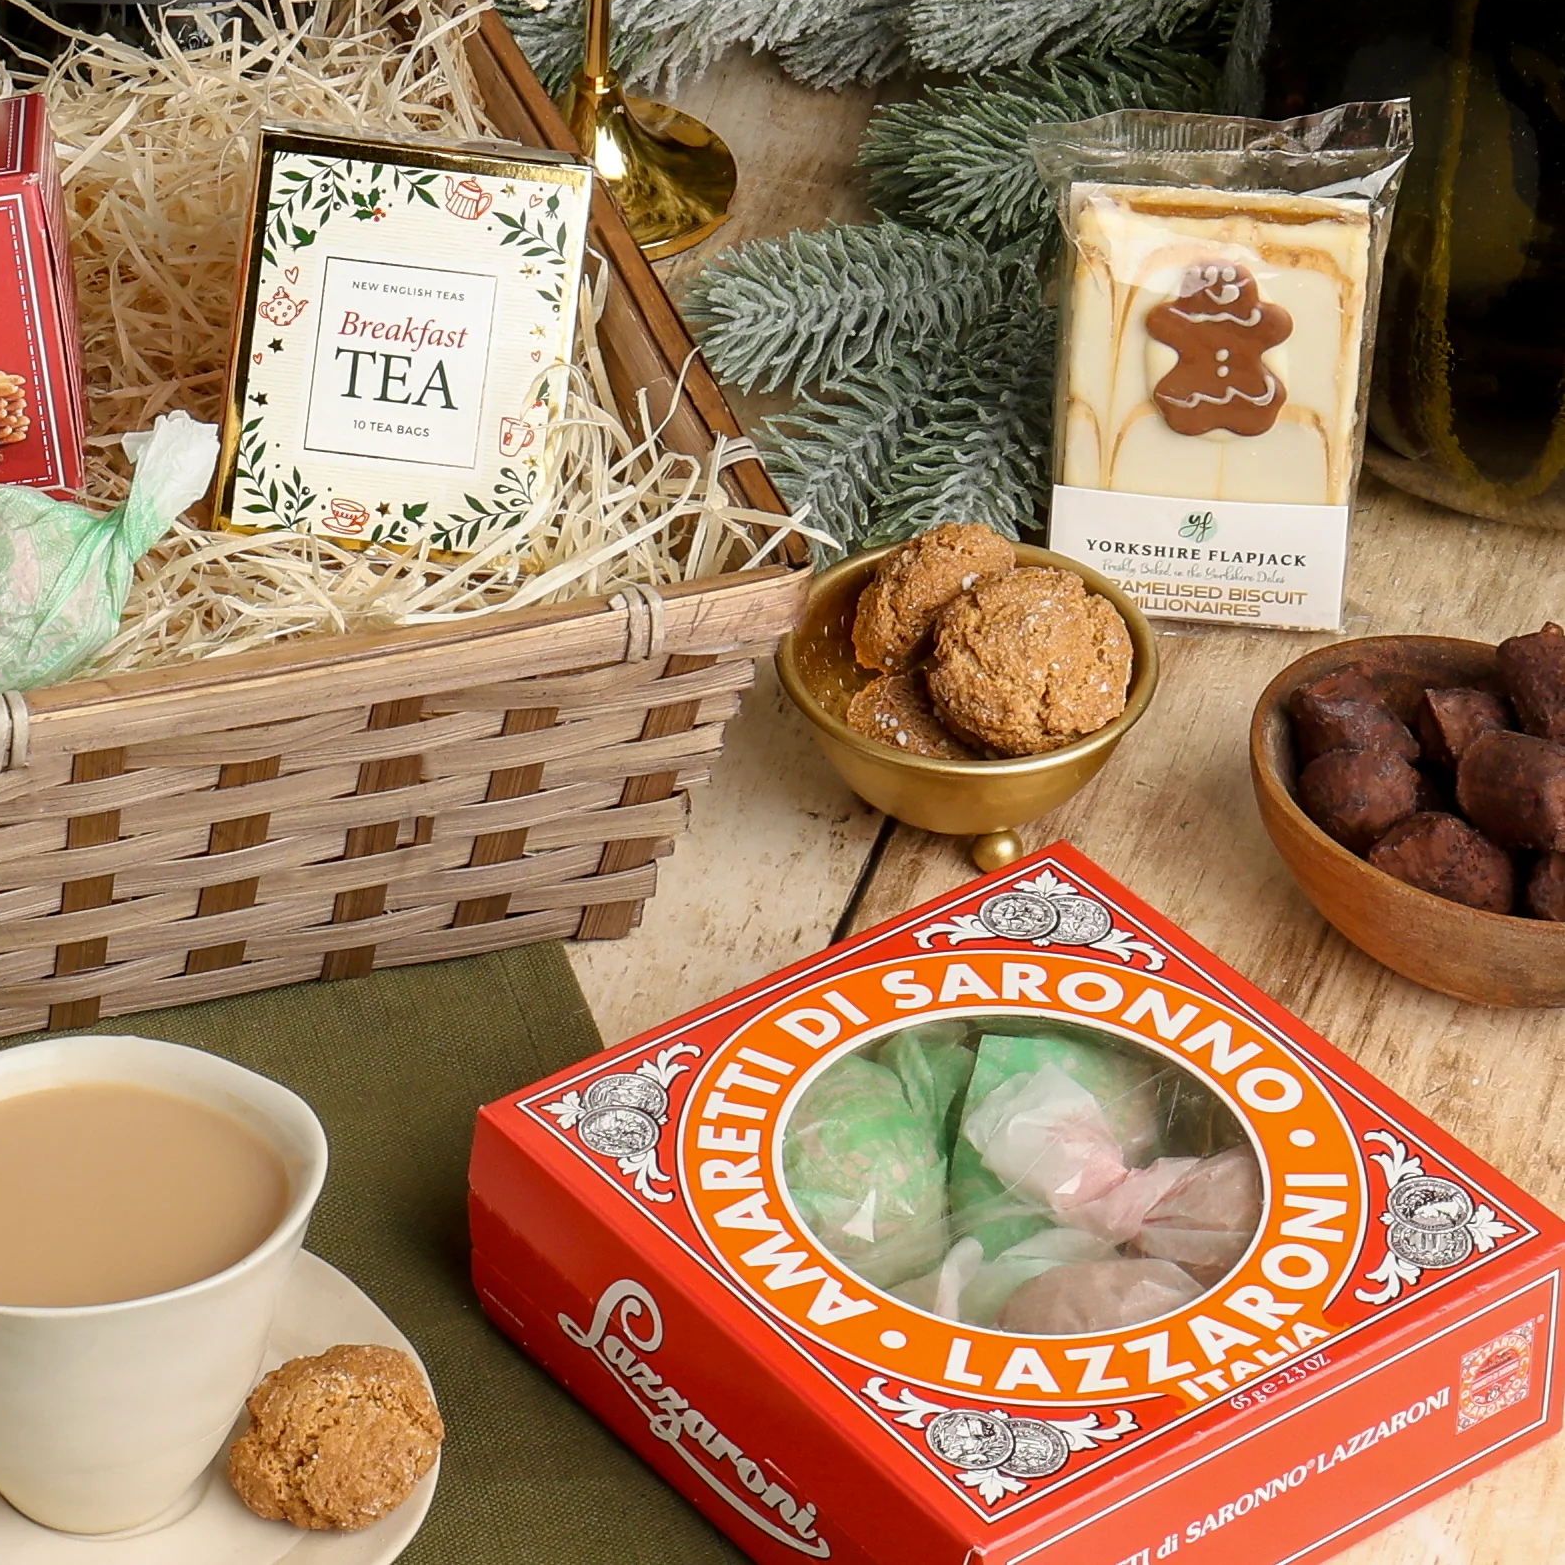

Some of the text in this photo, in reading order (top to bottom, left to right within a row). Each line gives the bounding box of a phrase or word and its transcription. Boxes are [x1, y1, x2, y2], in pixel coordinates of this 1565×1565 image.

[352, 280, 466, 302] NEW ENGLISH TEAS
[337, 310, 469, 351] Breakfast
[335, 346, 459, 411] TEA
[353, 419, 430, 437] 10 TEA BAGS
[1086, 538, 1307, 567] YORKSHIRE FLAPJACK
[1228, 588, 1308, 606] BISCUIT
[697, 962, 1304, 1326] AMARETTI DI SARONNO
[943, 1172, 1349, 1393] LAZZARONI
[1177, 1321, 1330, 1402] ITALIA
[557, 1279, 831, 1559] Lazzaroni
[1157, 1534, 1179, 1559] di
[1317, 1386, 1451, 1473] LAZZARONI
